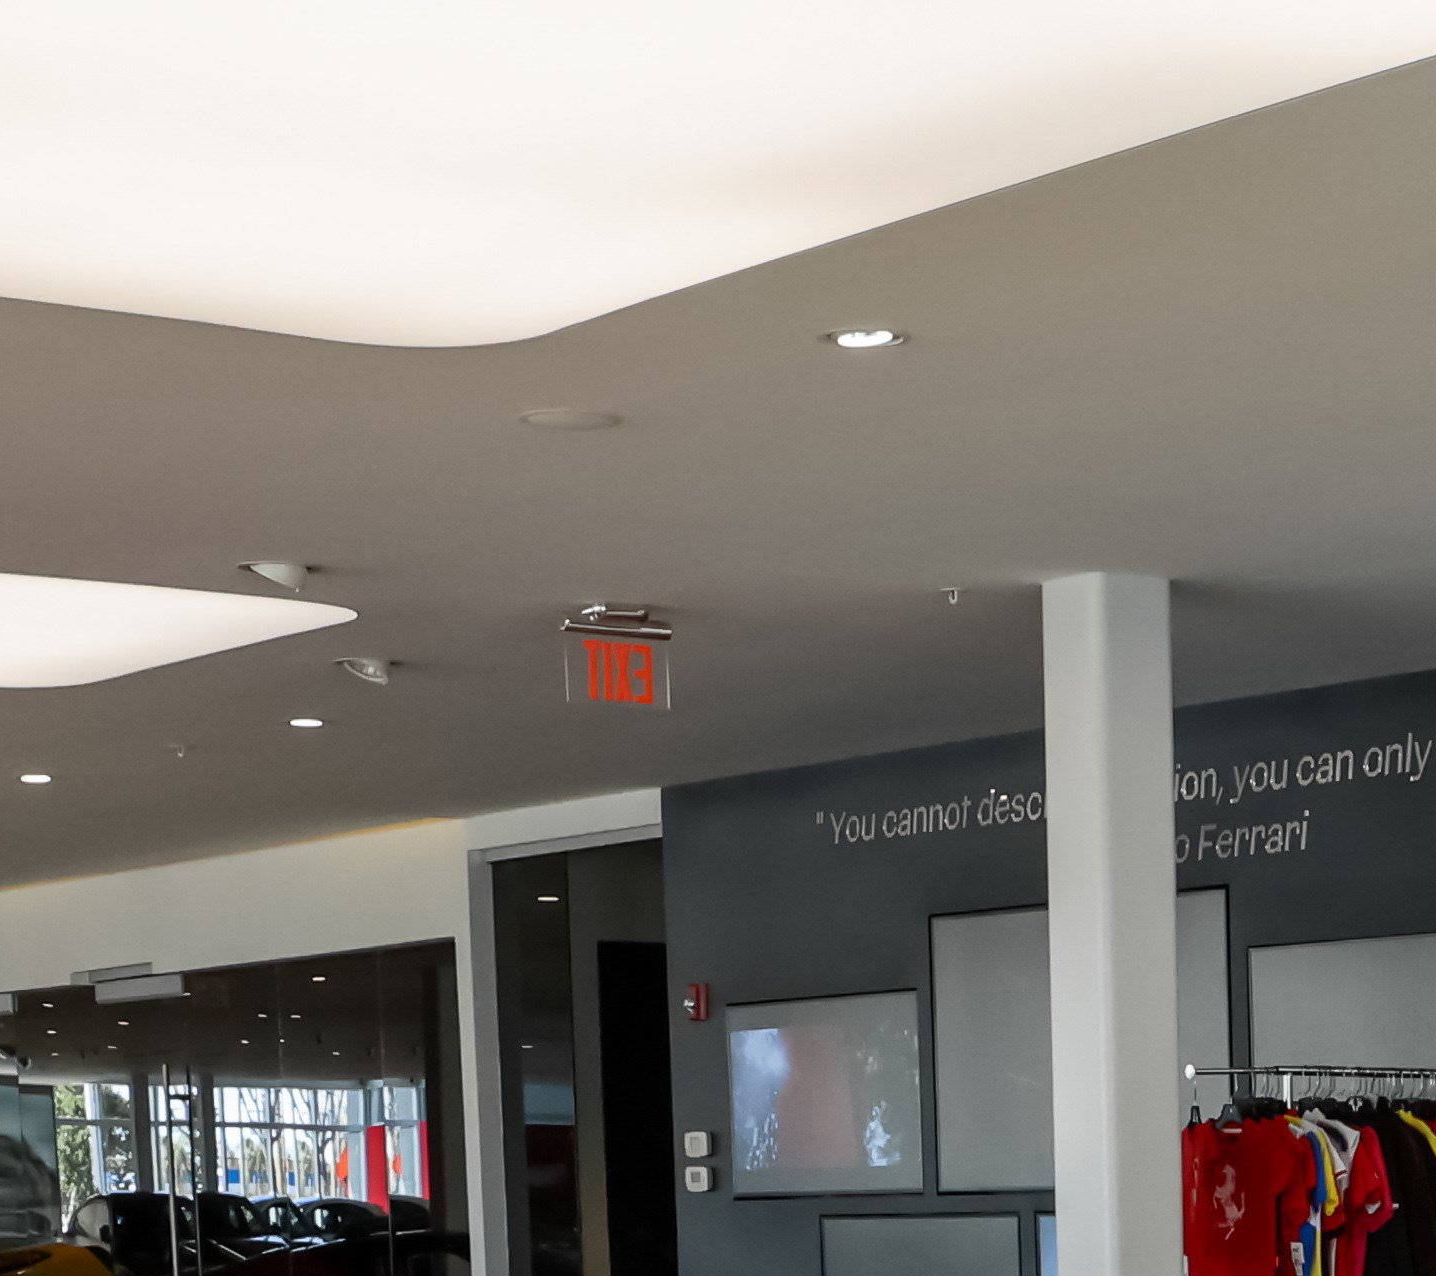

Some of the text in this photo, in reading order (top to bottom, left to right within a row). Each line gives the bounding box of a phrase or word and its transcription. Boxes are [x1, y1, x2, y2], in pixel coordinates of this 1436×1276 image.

[882, 795, 972, 838] cannot
[977, 788, 1048, 827] desc
[1174, 763, 1224, 805] ion,
[1229, 758, 1289, 804] you
[1296, 748, 1355, 787] can
[1362, 732, 1433, 782] only
[1197, 809, 1311, 862] Ferrari
